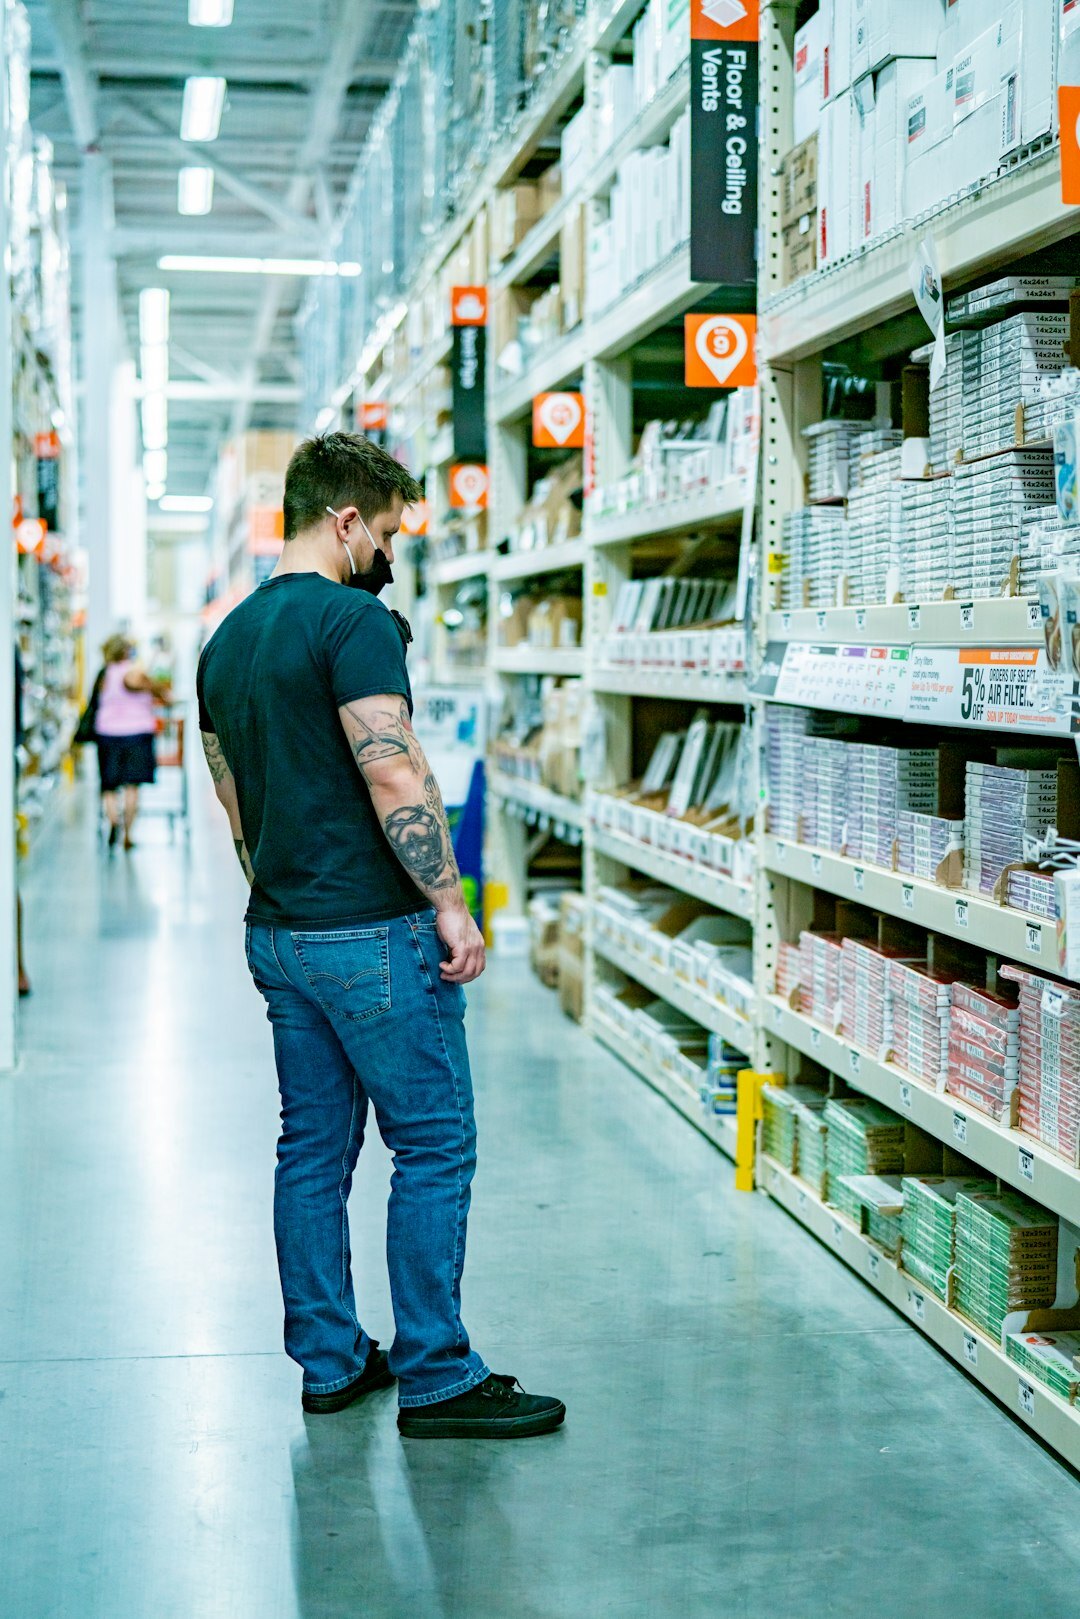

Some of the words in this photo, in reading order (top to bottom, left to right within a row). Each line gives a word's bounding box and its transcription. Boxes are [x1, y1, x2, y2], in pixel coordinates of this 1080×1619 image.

[701, 48, 723, 112] Vents
[726, 50, 747, 110] Floor
[726, 113, 747, 132] &
[721, 136, 747, 215] Ceiling
[713, 335, 730, 355] 9
[989, 668, 1009, 682] ORDERS
[1010, 669, 1017, 683] OF
[987, 683, 1002, 705] AIR
[1003, 684, 1034, 708] FILTE
[972, 703, 984, 721] OFF
[986, 710, 997, 722] SIGN
[997, 711, 1004, 723] UP
[1004, 712, 1019, 724] TODAY
